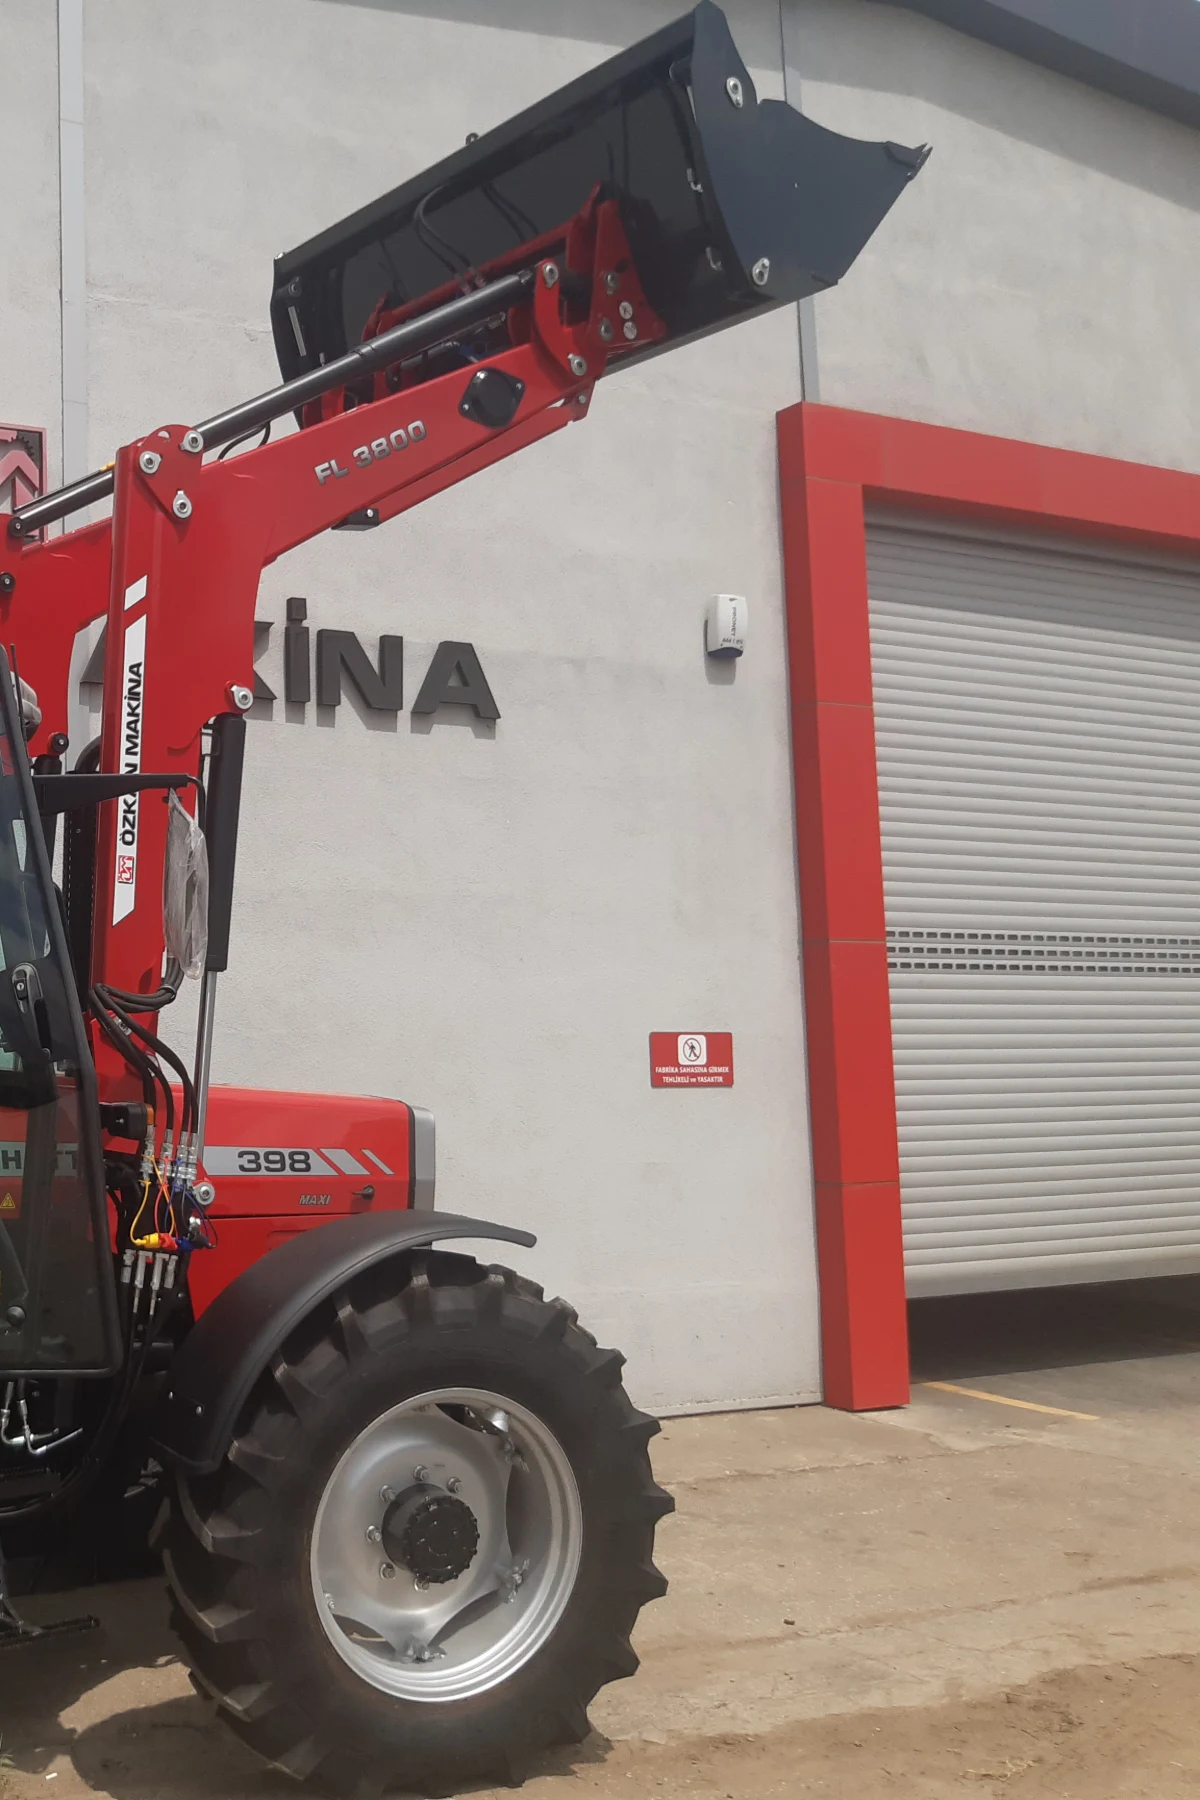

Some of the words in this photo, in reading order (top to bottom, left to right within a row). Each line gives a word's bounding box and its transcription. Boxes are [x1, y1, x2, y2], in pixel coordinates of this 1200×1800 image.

[314, 459, 350, 485] FL
[352, 420, 426, 468] 3800
[123, 661, 143, 757] MAKİNA
[119, 762, 139, 847] ÖZKN
[655, 1065, 679, 1073] FABRİKA
[237, 1150, 312, 1173] 398
[298, 1194, 331, 1206] MAXI
